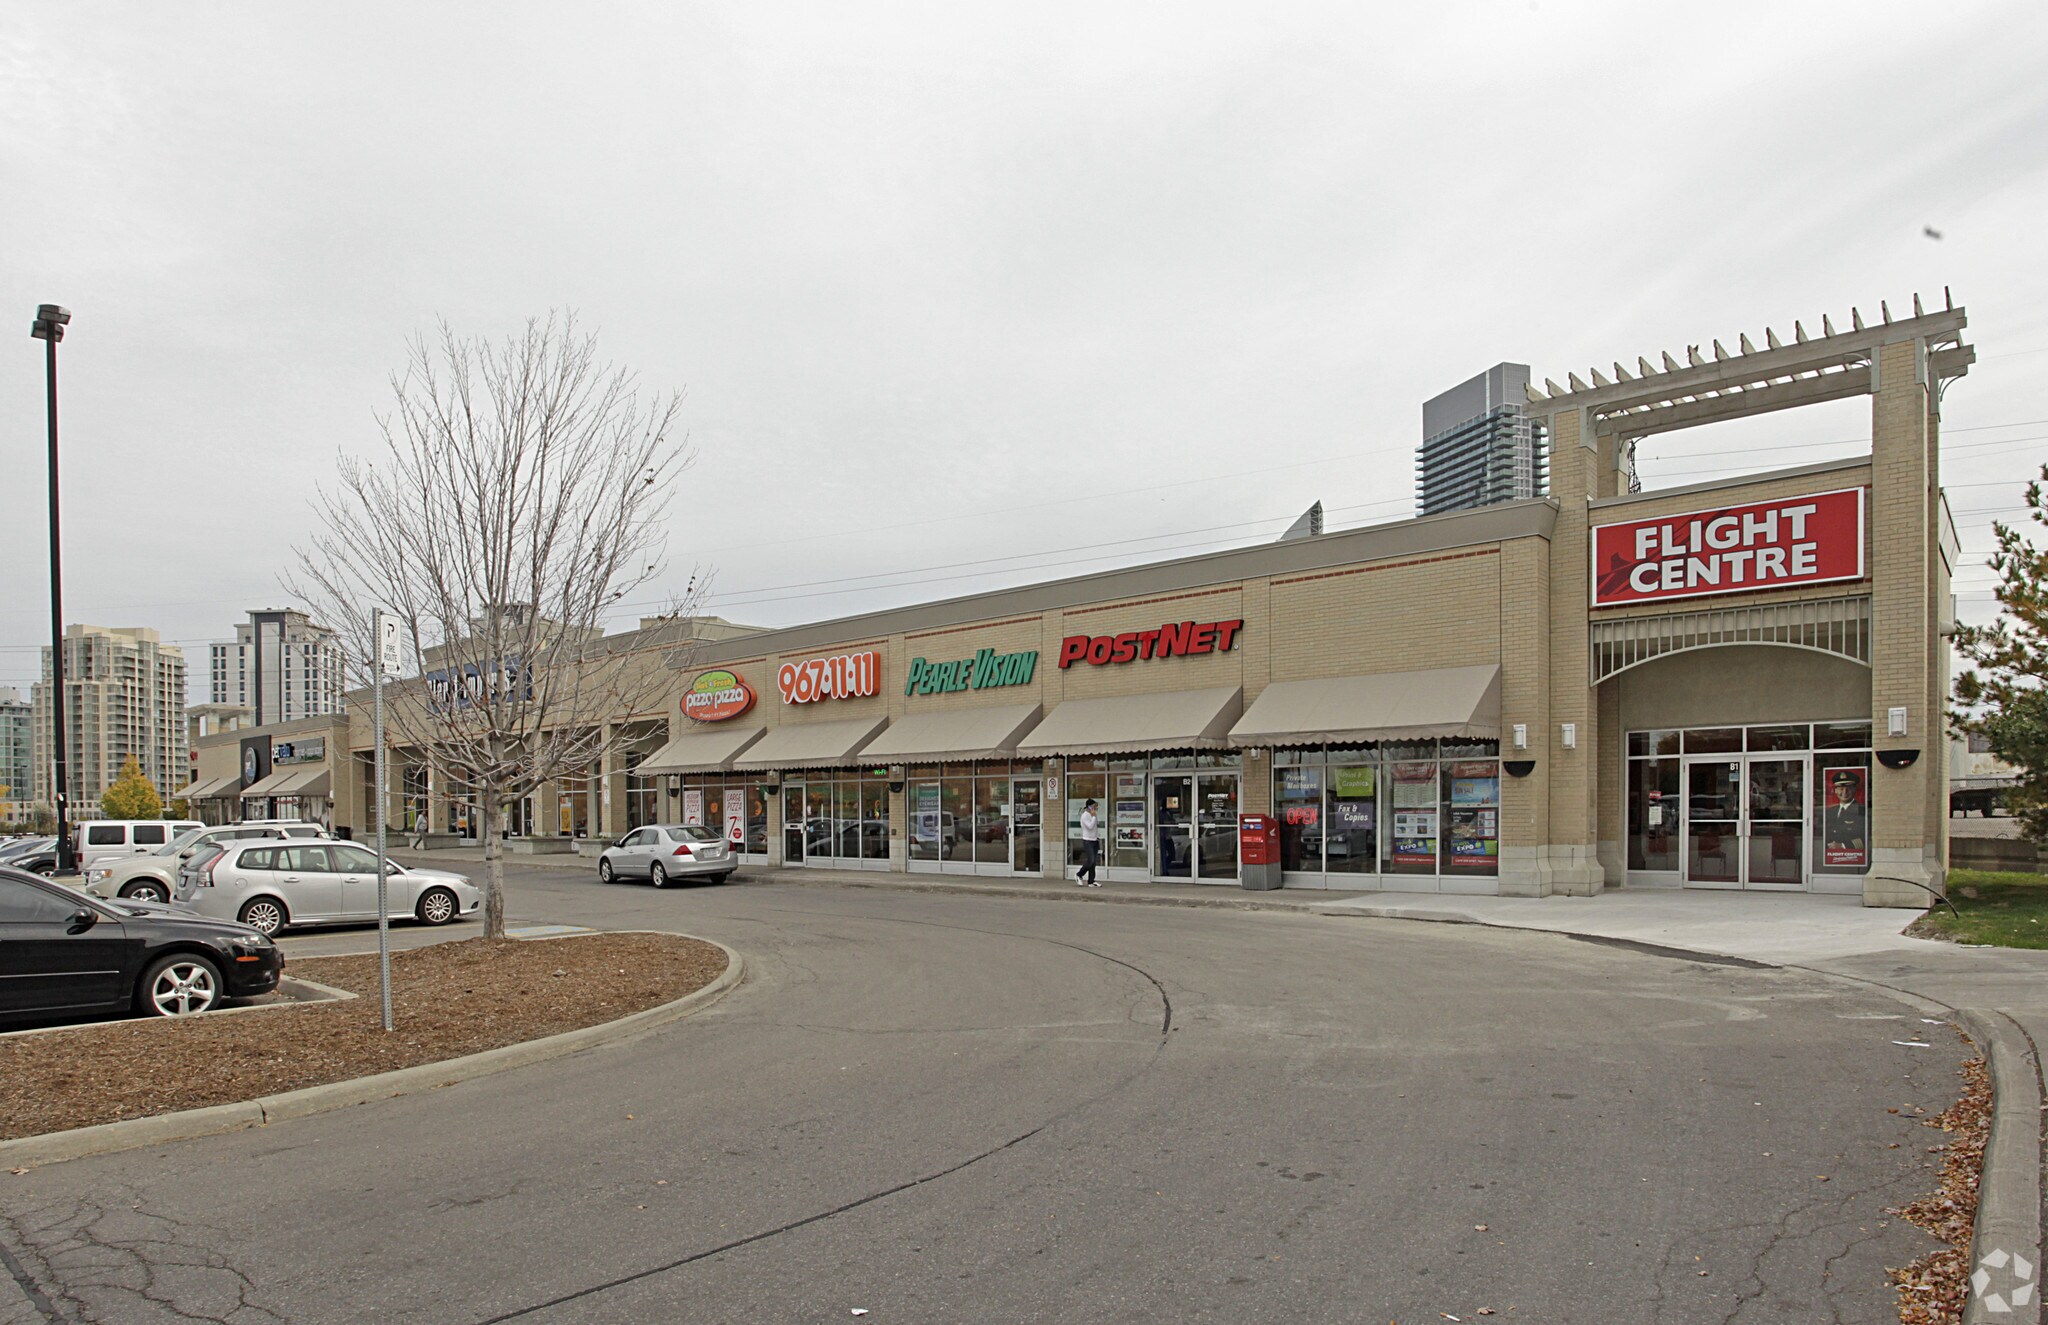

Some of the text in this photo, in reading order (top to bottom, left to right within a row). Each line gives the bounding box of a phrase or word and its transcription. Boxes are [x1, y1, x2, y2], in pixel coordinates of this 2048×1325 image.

[1635, 503, 1817, 560] FLIGHT
[1629, 541, 1818, 593] CENTRE
[386, 644, 396, 654] FIRE
[1058, 619, 1243, 669] POSTNET
[384, 653, 398, 663] ROUTE
[905, 648, 1039, 696] PEARLE VISION
[686, 688, 744, 712] pizza pizza
[1730, 762, 1739, 770] B1
[727, 793, 742, 801] LARGE
[686, 803, 700, 813] PIZZA
[727, 802, 742, 812] PIZZA
[1338, 804, 1358, 813] Fax &
[1286, 807, 1318, 825] OPEN
[1344, 813, 1369, 822] Copies
[1118, 829, 1143, 840] FedEx
